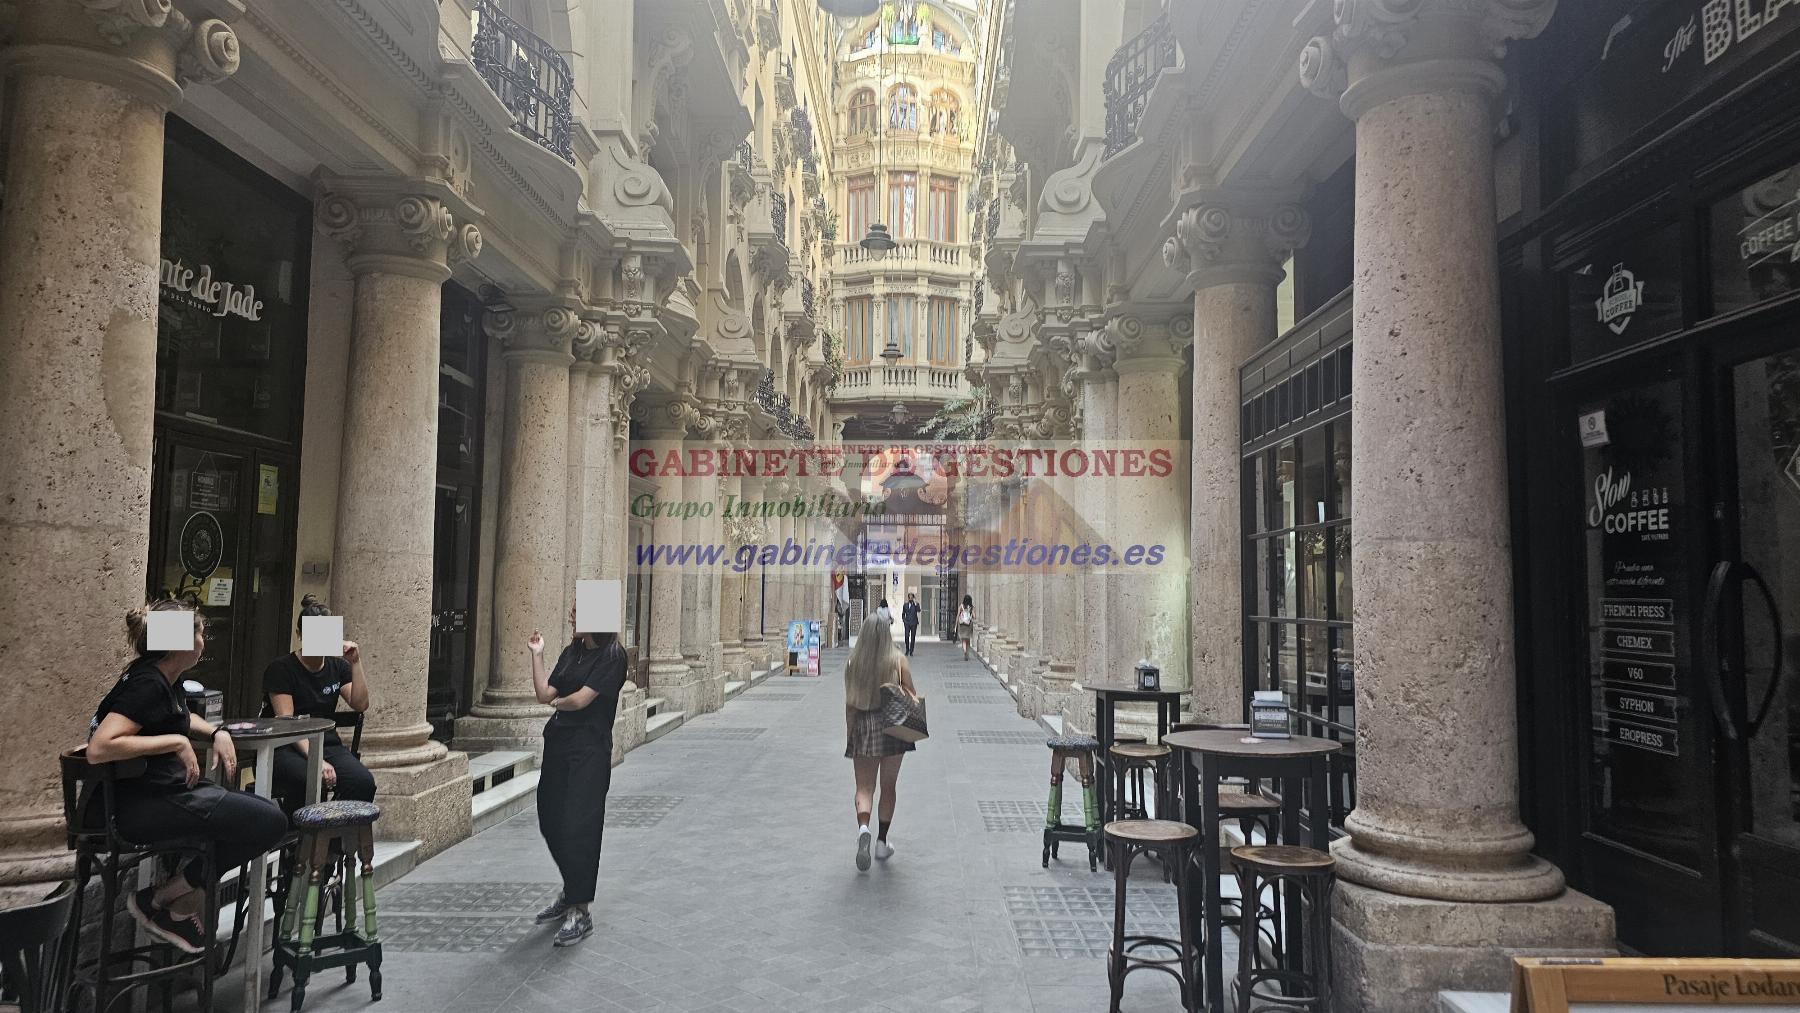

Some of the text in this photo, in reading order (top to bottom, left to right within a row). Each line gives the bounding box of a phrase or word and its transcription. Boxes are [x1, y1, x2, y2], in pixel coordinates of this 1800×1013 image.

[1662, 13, 1697, 72] The
[1740, 216, 1793, 259] COFFEE
[191, 264, 221, 303] de
[212, 281, 264, 321] Jade
[1606, 300, 1635, 318] COFFEE
[1589, 464, 1631, 528] Slow
[1605, 508, 1669, 534] COFFEE
[1604, 604, 1665, 618] FRENCH PRESS
[1616, 635, 1652, 649] CHEMEX
[1627, 667, 1644, 681] V60
[1619, 696, 1654, 713] SYPHON
[1619, 727, 1664, 748] EROPRESS
[1663, 972, 1729, 1001] Pasaje
